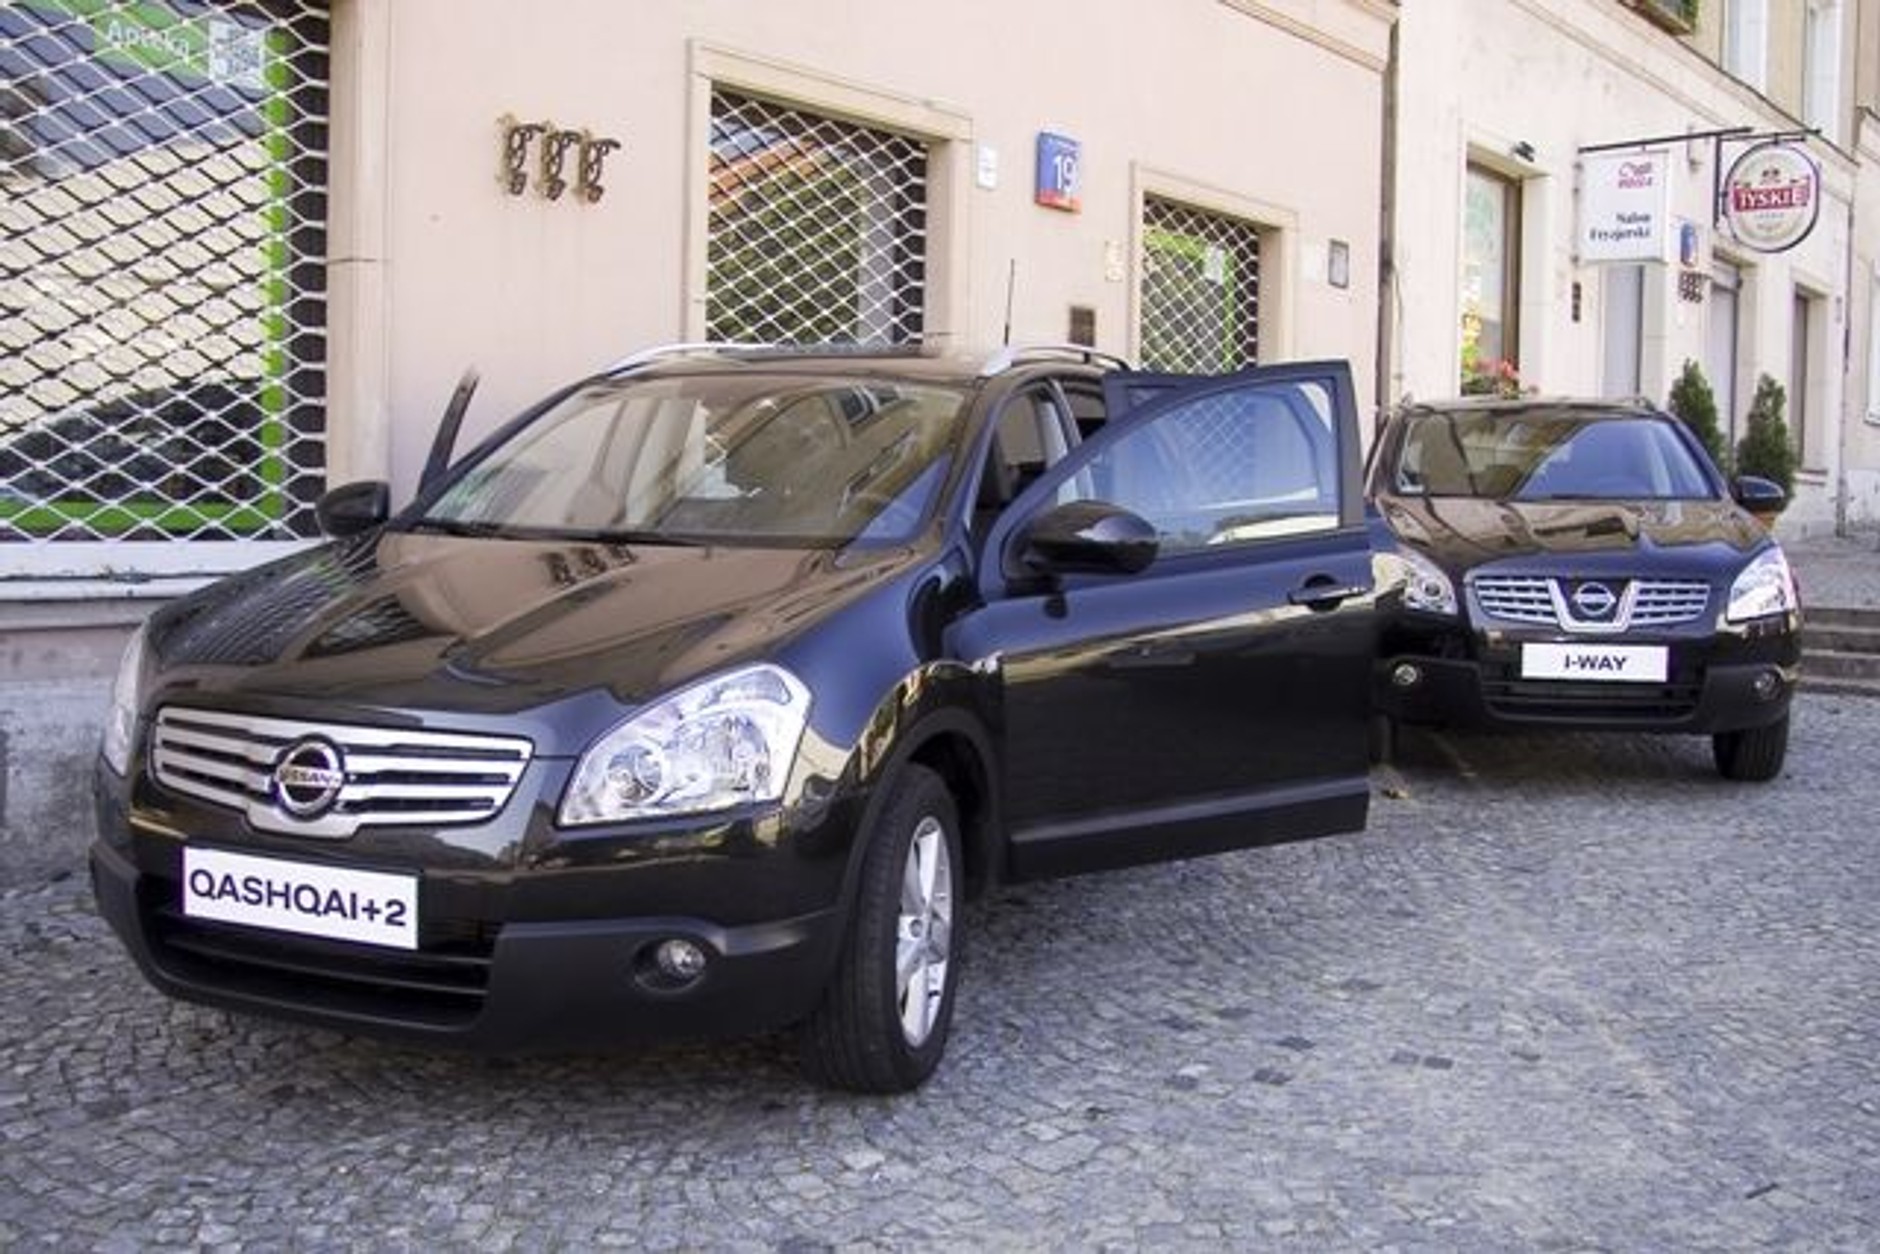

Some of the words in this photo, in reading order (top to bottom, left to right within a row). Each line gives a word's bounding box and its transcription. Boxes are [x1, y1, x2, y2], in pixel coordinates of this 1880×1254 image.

[1053, 153, 1076, 192] 19
[1739, 186, 1804, 207] TYSKIE
[1563, 654, 1627, 671] I-WAY
[189, 868, 408, 927] QASHQAI+2
